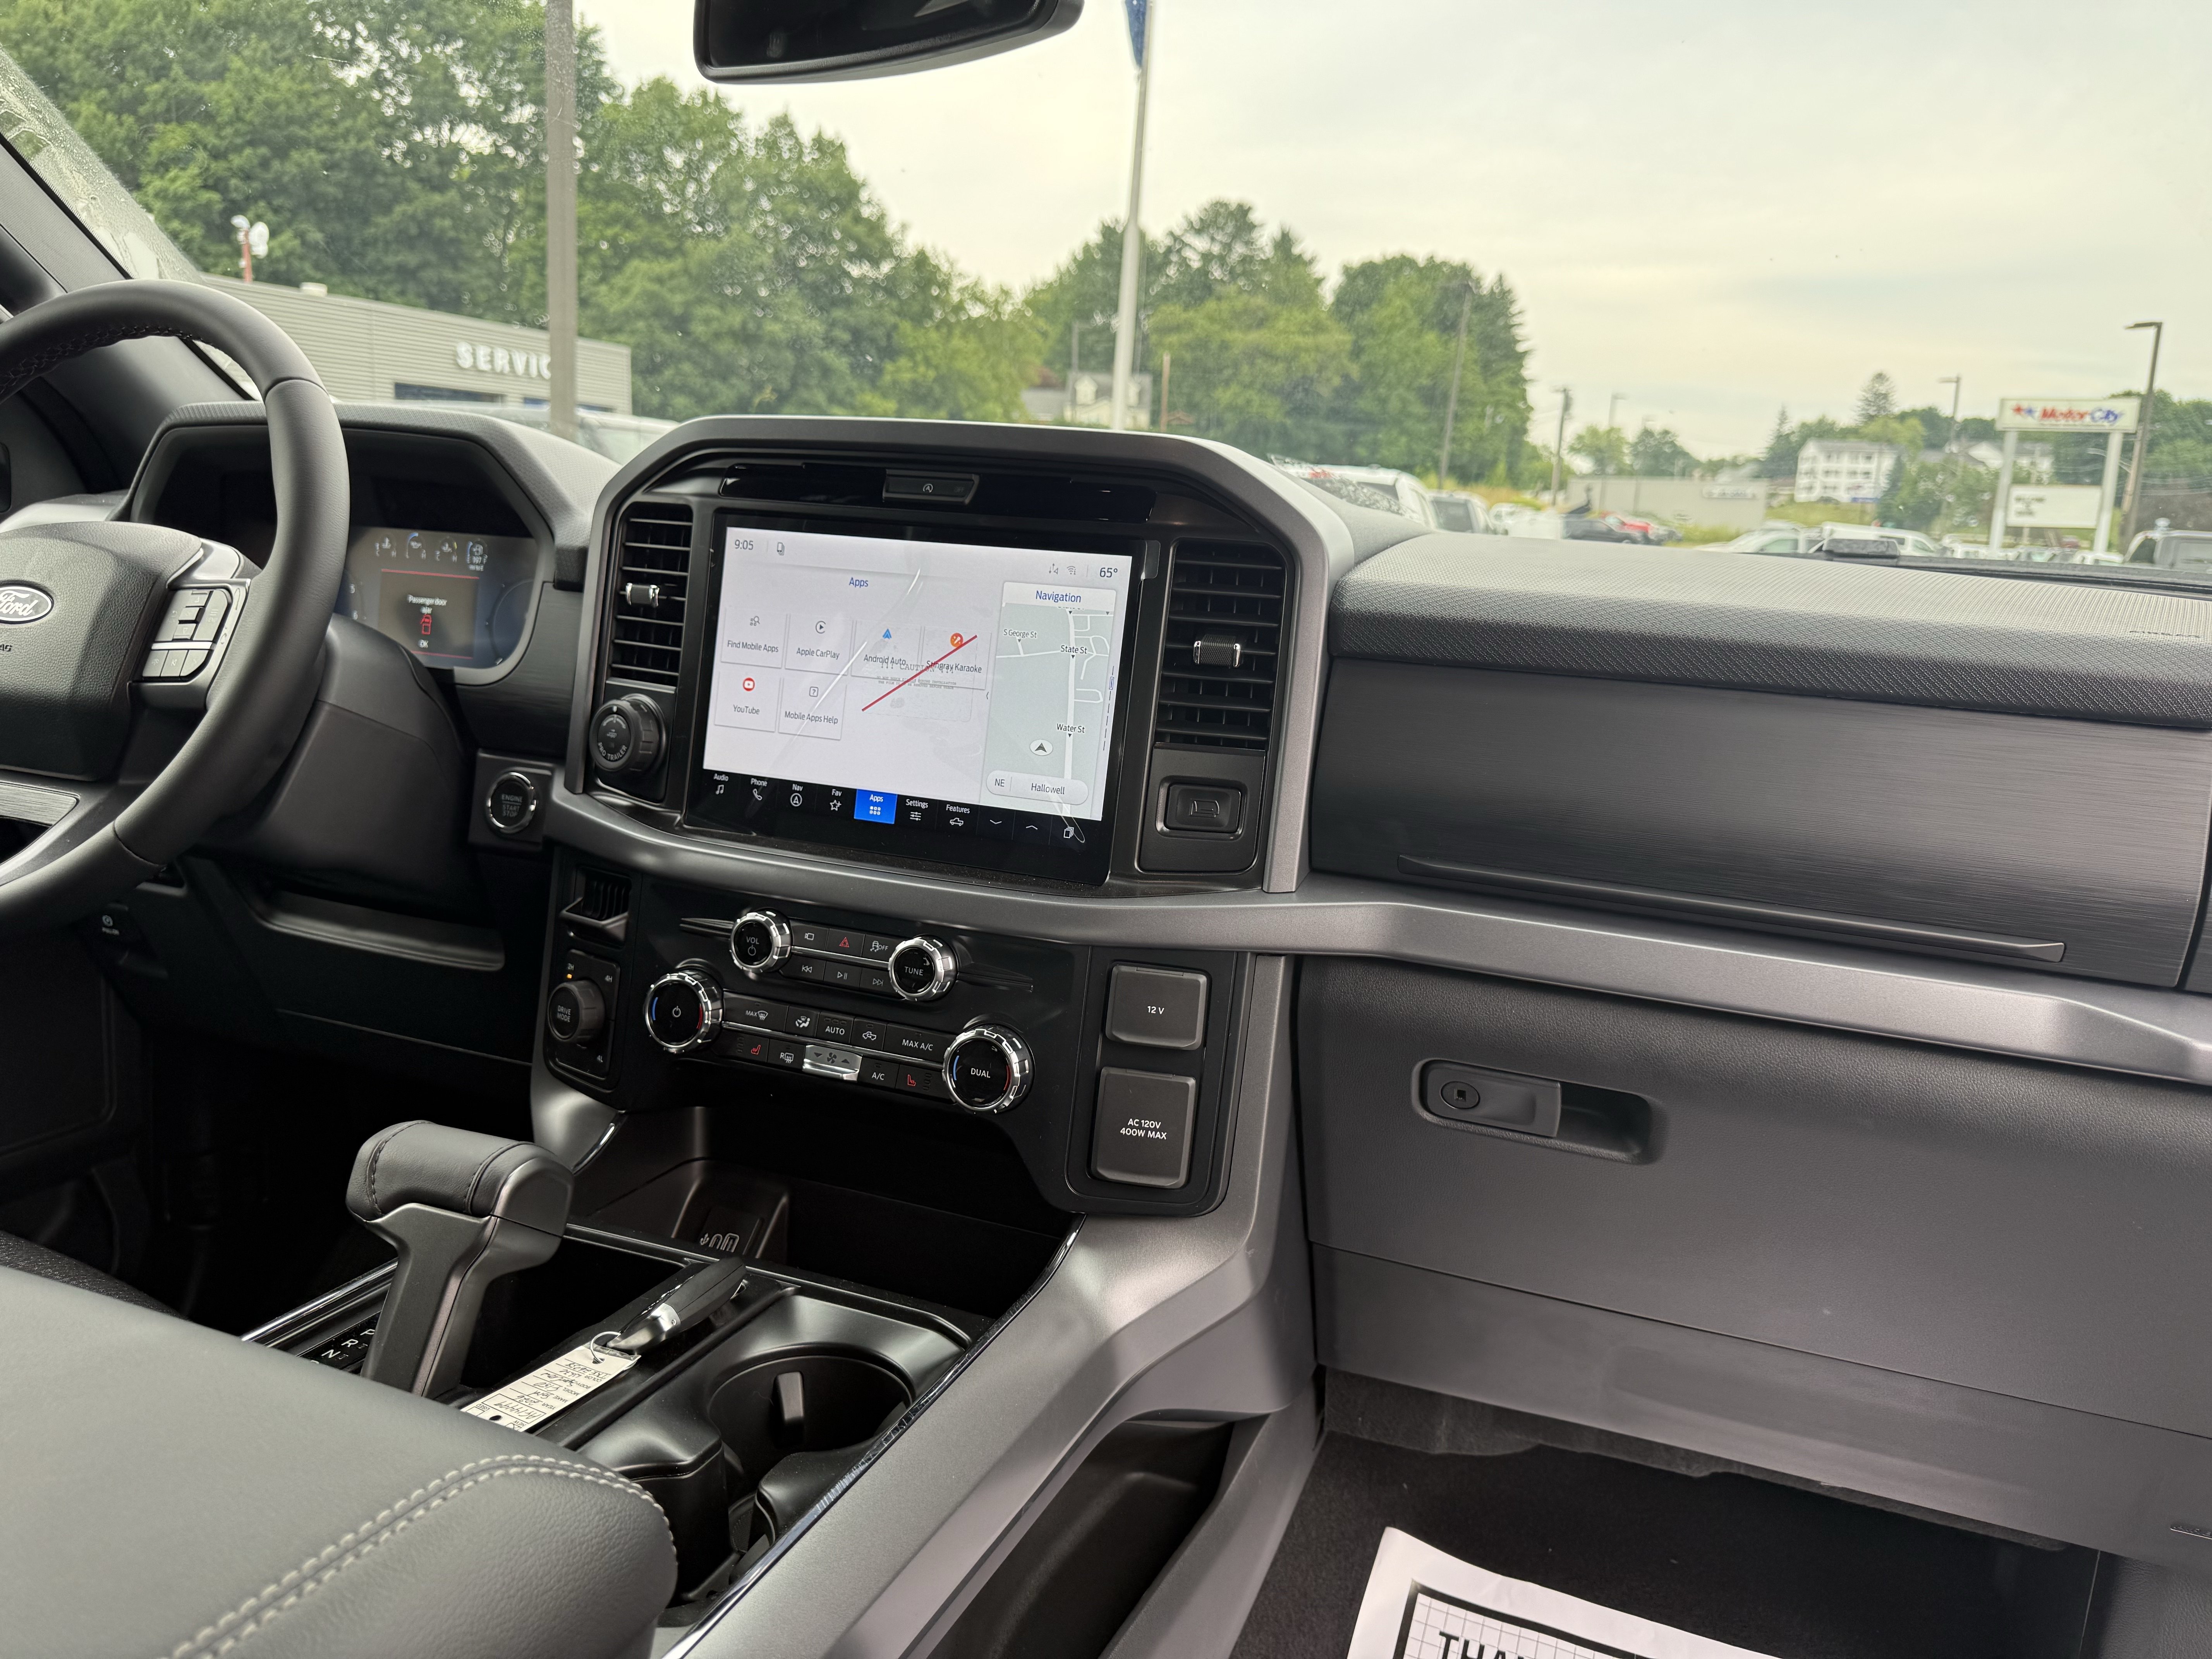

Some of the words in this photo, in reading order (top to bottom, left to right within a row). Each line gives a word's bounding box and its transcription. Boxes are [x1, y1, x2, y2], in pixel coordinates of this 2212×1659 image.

[456, 342, 551, 380] SERVIC
[734, 539, 754, 550] 9:05
[1099, 567, 1118, 578] 65°
[849, 577, 868, 588] Apps
[1036, 590, 1082, 603] Navigation
[0, 590, 39, 617] Ford
[1008, 629, 1029, 639] George
[727, 640, 740, 648] Find
[742, 642, 762, 651] Mobile
[763, 644, 779, 653] Apps
[1061, 645, 1079, 654] State
[796, 647, 815, 656] Apple
[816, 649, 840, 660] CarPlay
[864, 654, 889, 663] Android
[890, 657, 906, 665] Auto
[955, 663, 982, 673] Karaoke
[733, 704, 760, 715] YouTube
[785, 711, 805, 720] Mobile
[806, 714, 822, 723] Apps
[823, 715, 838, 725] Help
[1056, 723, 1076, 732] Water
[598, 742, 606, 756] PRO
[608, 745, 627, 761] TRAILER
[713, 773, 729, 781] Audio
[751, 778, 768, 787] Phone
[994, 778, 1005, 787] NE
[832, 788, 842, 797] Fav
[1031, 782, 1065, 795] Hallowell
[501, 794, 522, 802] ENGINE
[869, 794, 883, 803] Apps
[906, 799, 929, 809] Settings
[946, 804, 970, 814] Features
[746, 936, 759, 945] VOL
[904, 966, 924, 976] TUNE
[557, 1005, 571, 1015] DRIVE
[1147, 1006, 1156, 1014] 12
[557, 1012, 570, 1022] MODE
[825, 1026, 845, 1035] AUTO
[902, 1039, 919, 1048] MAX
[920, 1043, 933, 1051] A/C
[872, 1072, 884, 1080] A/C
[970, 1068, 991, 1078] DUAL
[1128, 1118, 1139, 1127] AC
[1141, 1120, 1161, 1129] 120V
[1120, 1127, 1146, 1137] 400W
[1147, 1130, 1167, 1140] MAX
[341, 1339, 359, 1347] R
[321, 1349, 341, 1358] N
[561, 1387, 581, 1396] MODEL
[516, 1395, 539, 1405] 2026
